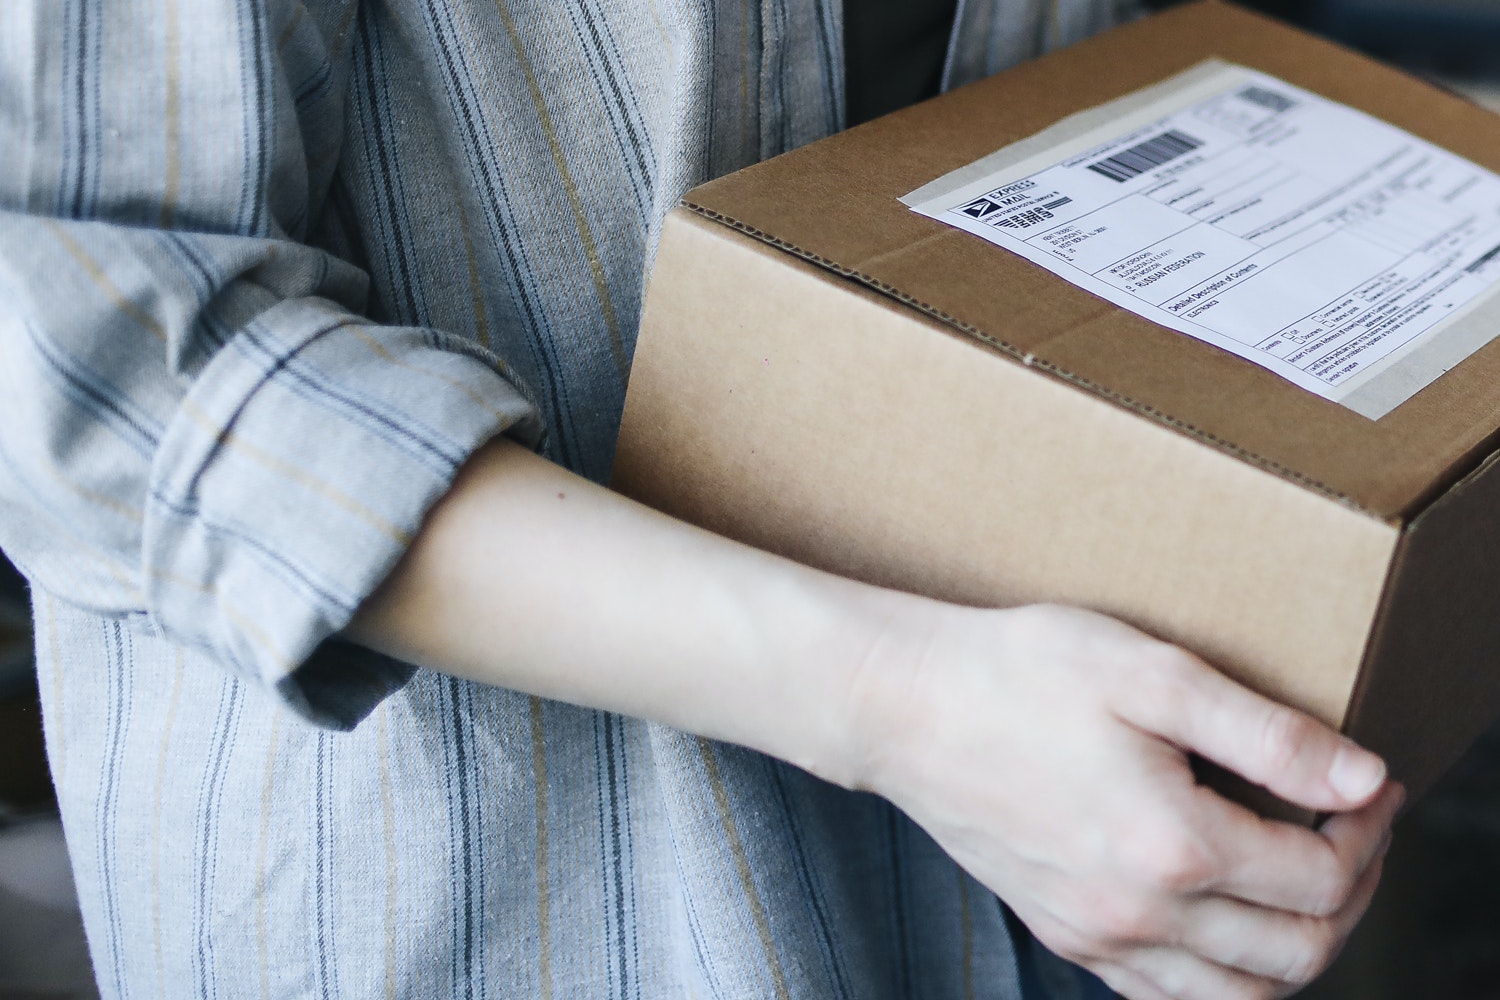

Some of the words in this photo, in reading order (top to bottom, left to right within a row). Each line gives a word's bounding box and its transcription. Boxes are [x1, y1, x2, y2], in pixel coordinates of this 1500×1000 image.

[989, 180, 1035, 199] EXPRESS
[1001, 194, 1030, 205] MAIL
[1135, 270, 1167, 287] RUSSIAN
[1163, 252, 1205, 273] FEDERATION
[1168, 297, 1196, 311] Detailed
[1191, 280, 1227, 299] Description
[1230, 264, 1257, 278] Contents
